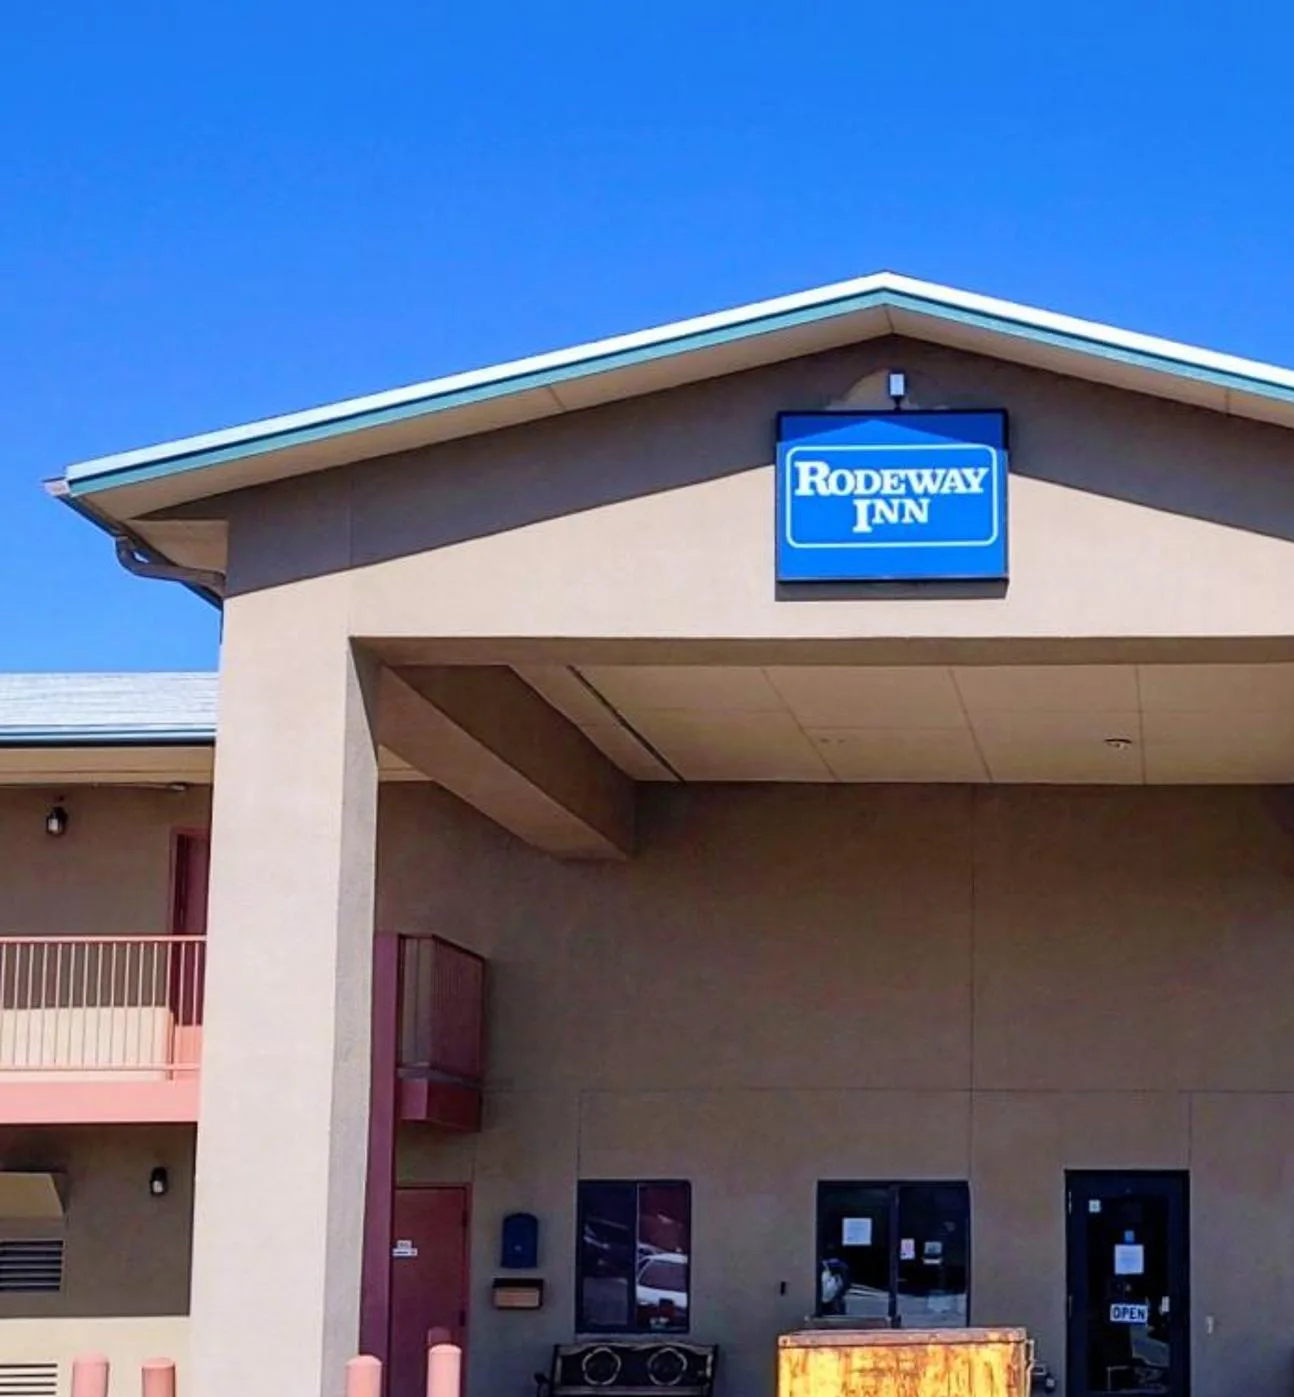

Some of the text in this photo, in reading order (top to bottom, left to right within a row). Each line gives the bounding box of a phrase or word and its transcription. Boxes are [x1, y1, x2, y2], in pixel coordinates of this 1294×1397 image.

[793, 460, 989, 497] RODEWAY
[852, 498, 932, 533] INN
[1112, 1306, 1146, 1320] OPEN
